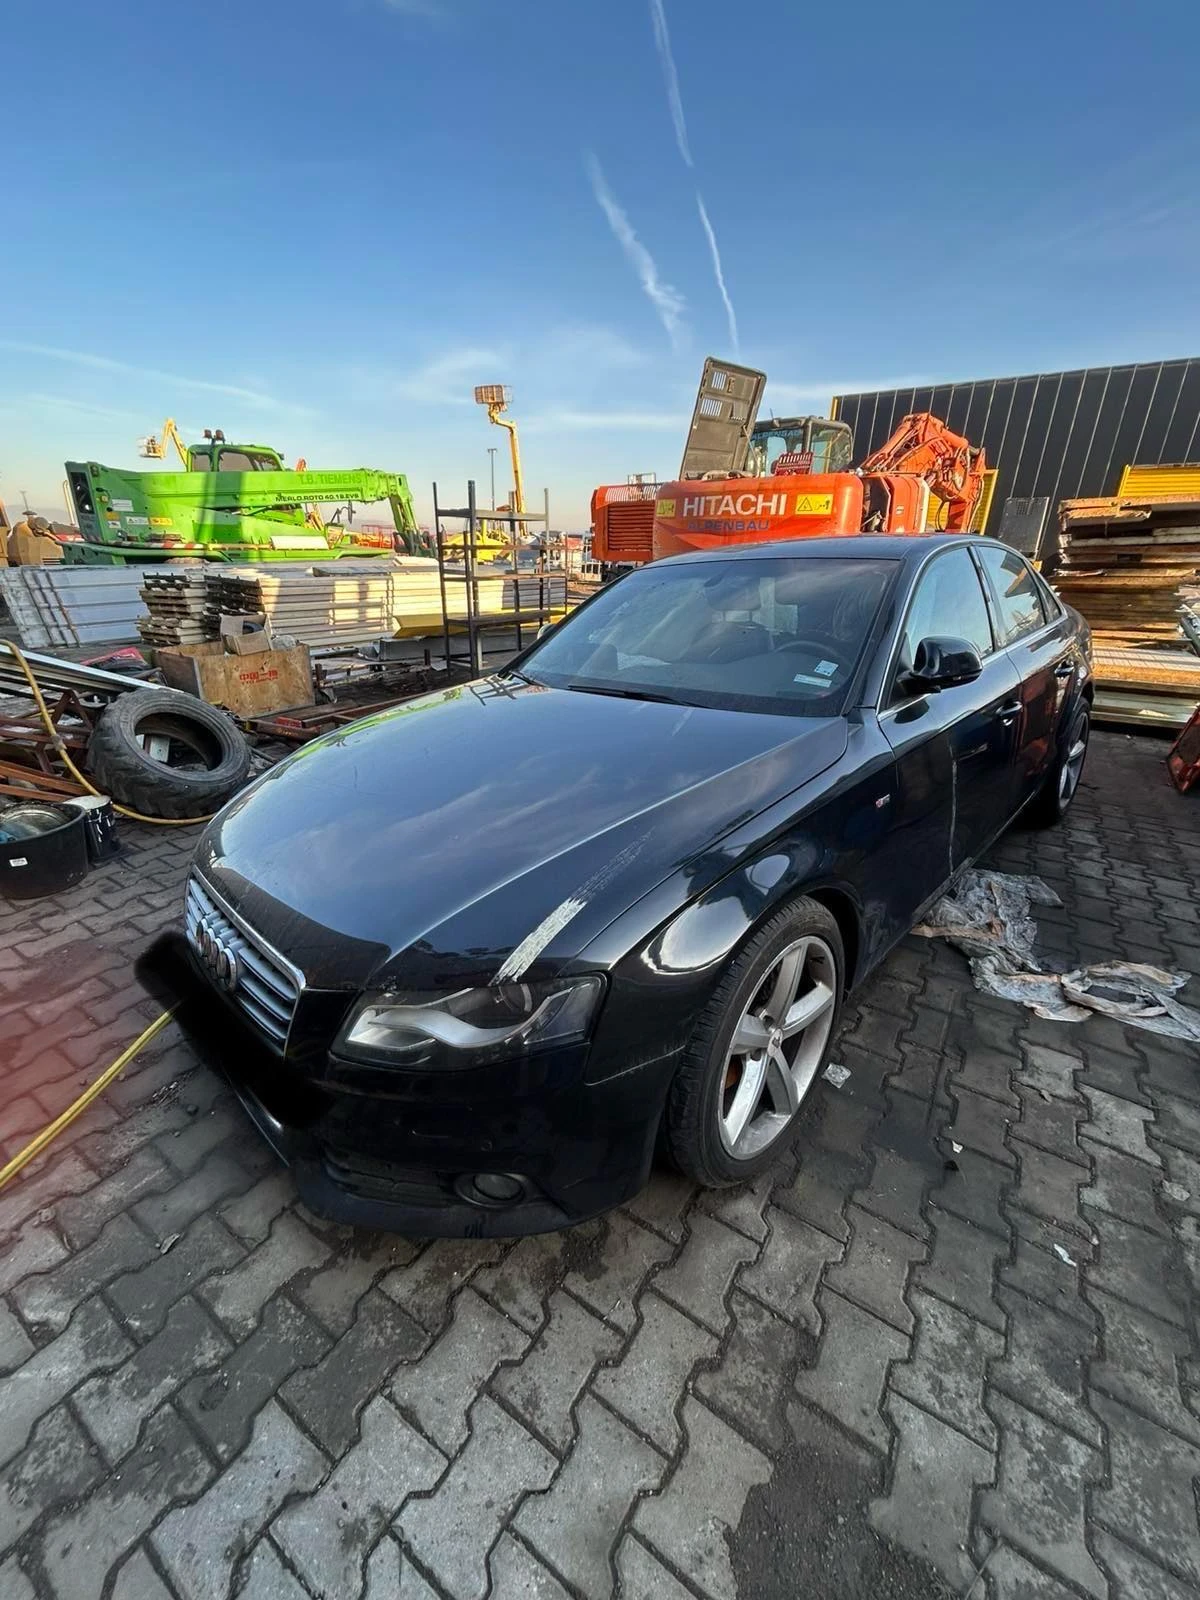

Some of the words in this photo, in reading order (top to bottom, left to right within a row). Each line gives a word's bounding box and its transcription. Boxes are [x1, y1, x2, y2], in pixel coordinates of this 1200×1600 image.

[318, 473, 362, 485] TIEMENS
[683, 494, 787, 517] HITACHI
[688, 520, 769, 532] ALPENBAU
